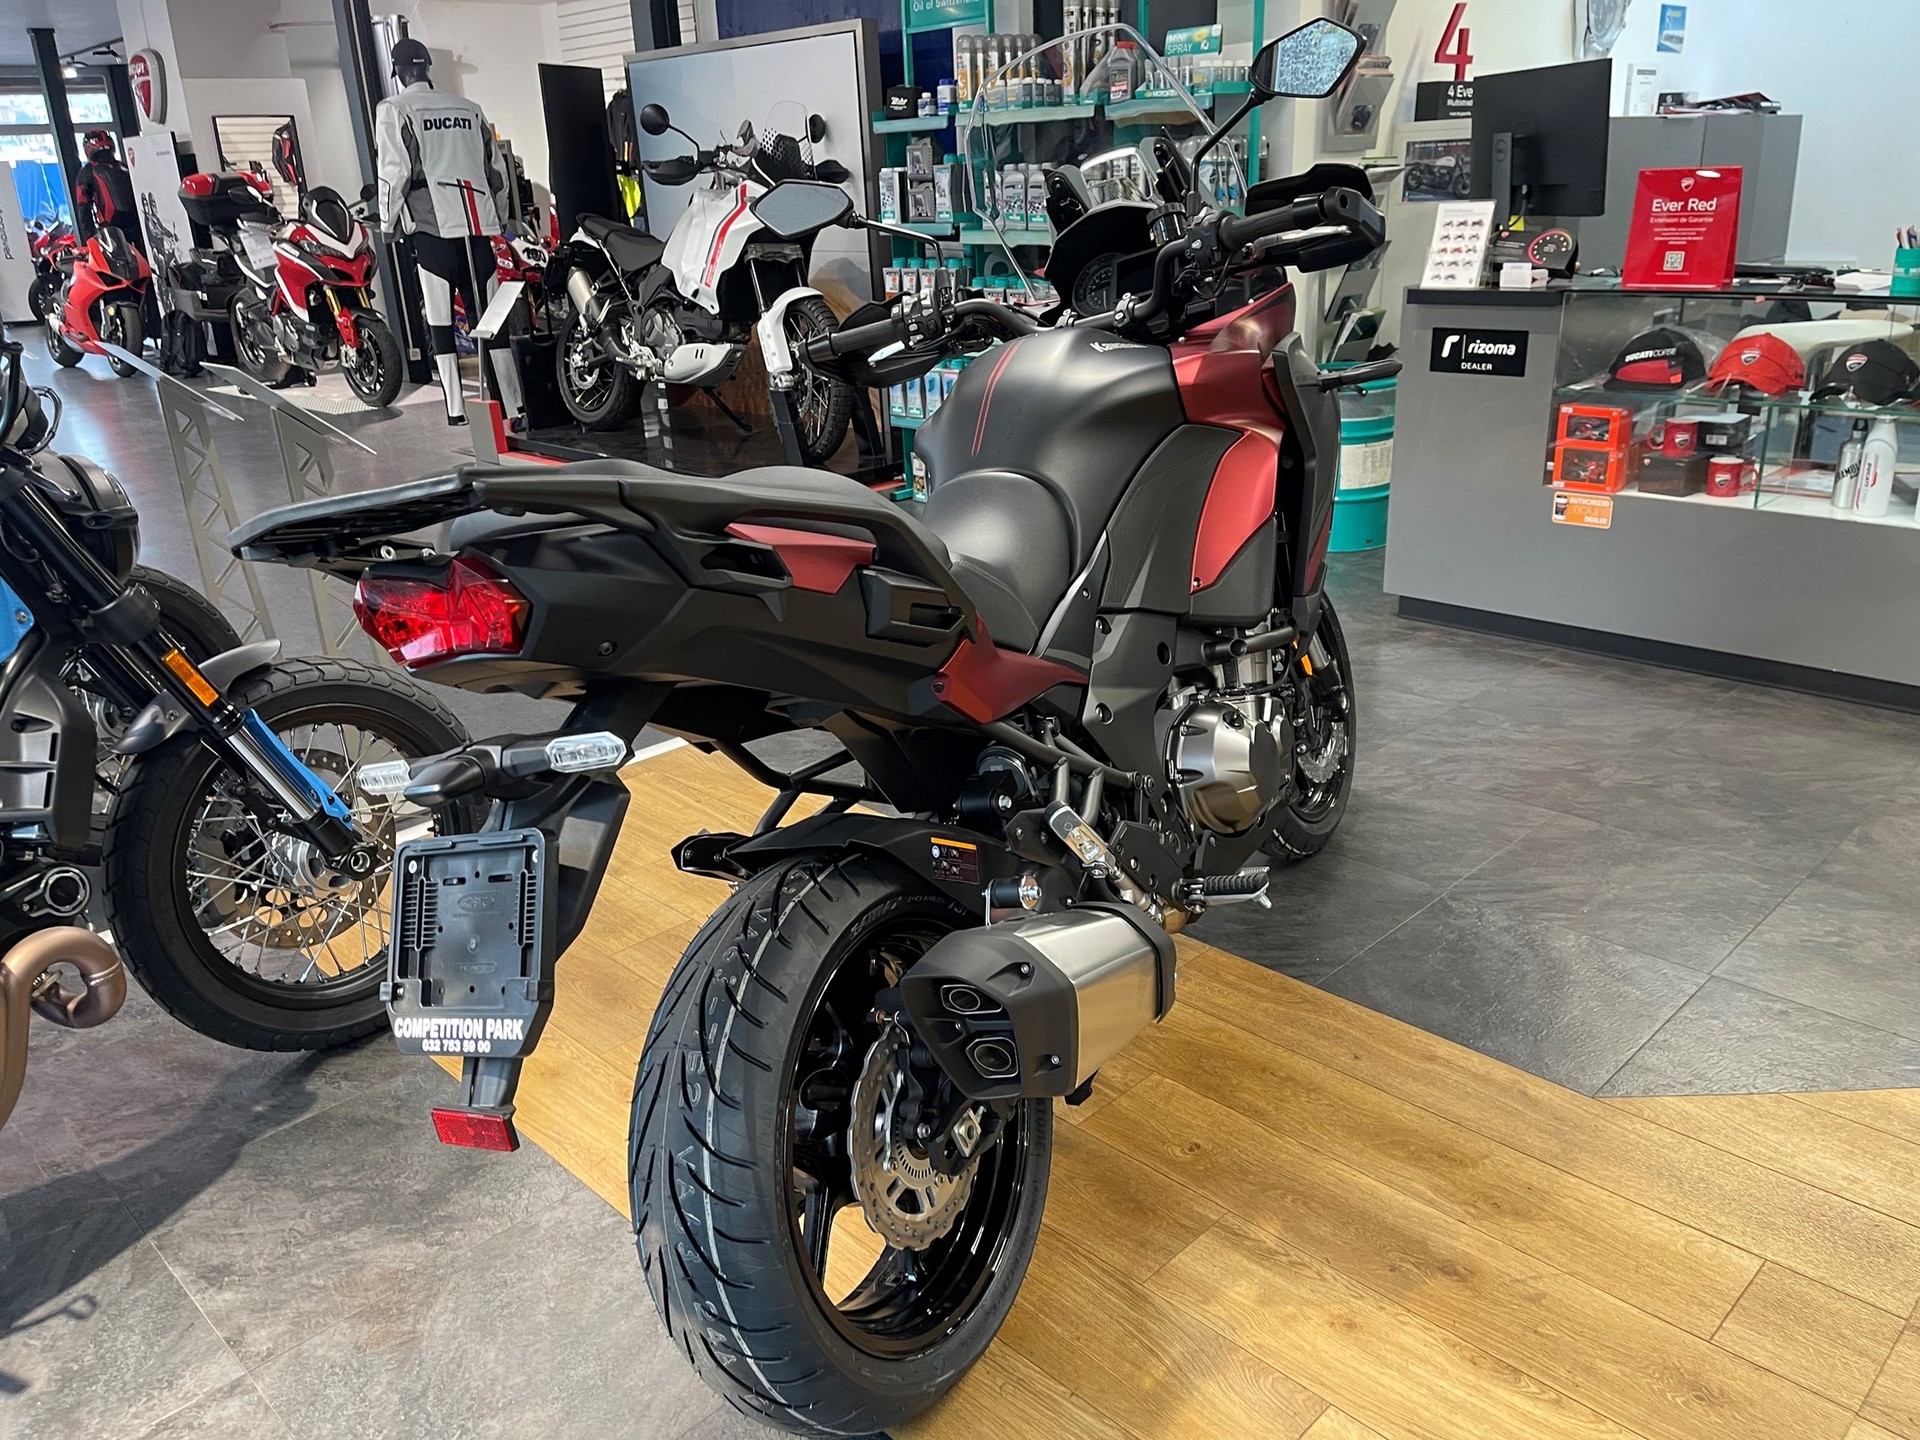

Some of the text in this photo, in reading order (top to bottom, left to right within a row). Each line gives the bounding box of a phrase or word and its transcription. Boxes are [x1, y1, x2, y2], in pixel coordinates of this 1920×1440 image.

[1167, 42, 1193, 55] SPRAY
[1447, 84, 1474, 98] 4 Eve
[423, 117, 472, 131] DUCATI
[1651, 197, 1718, 212] Ever Red
[1467, 339, 1516, 356] rizoma
[1460, 362, 1493, 371] DEALER
[394, 1017, 524, 1041] COMPETITION PARK
[422, 1039, 441, 1052] 032
[477, 1040, 491, 1053] 00
